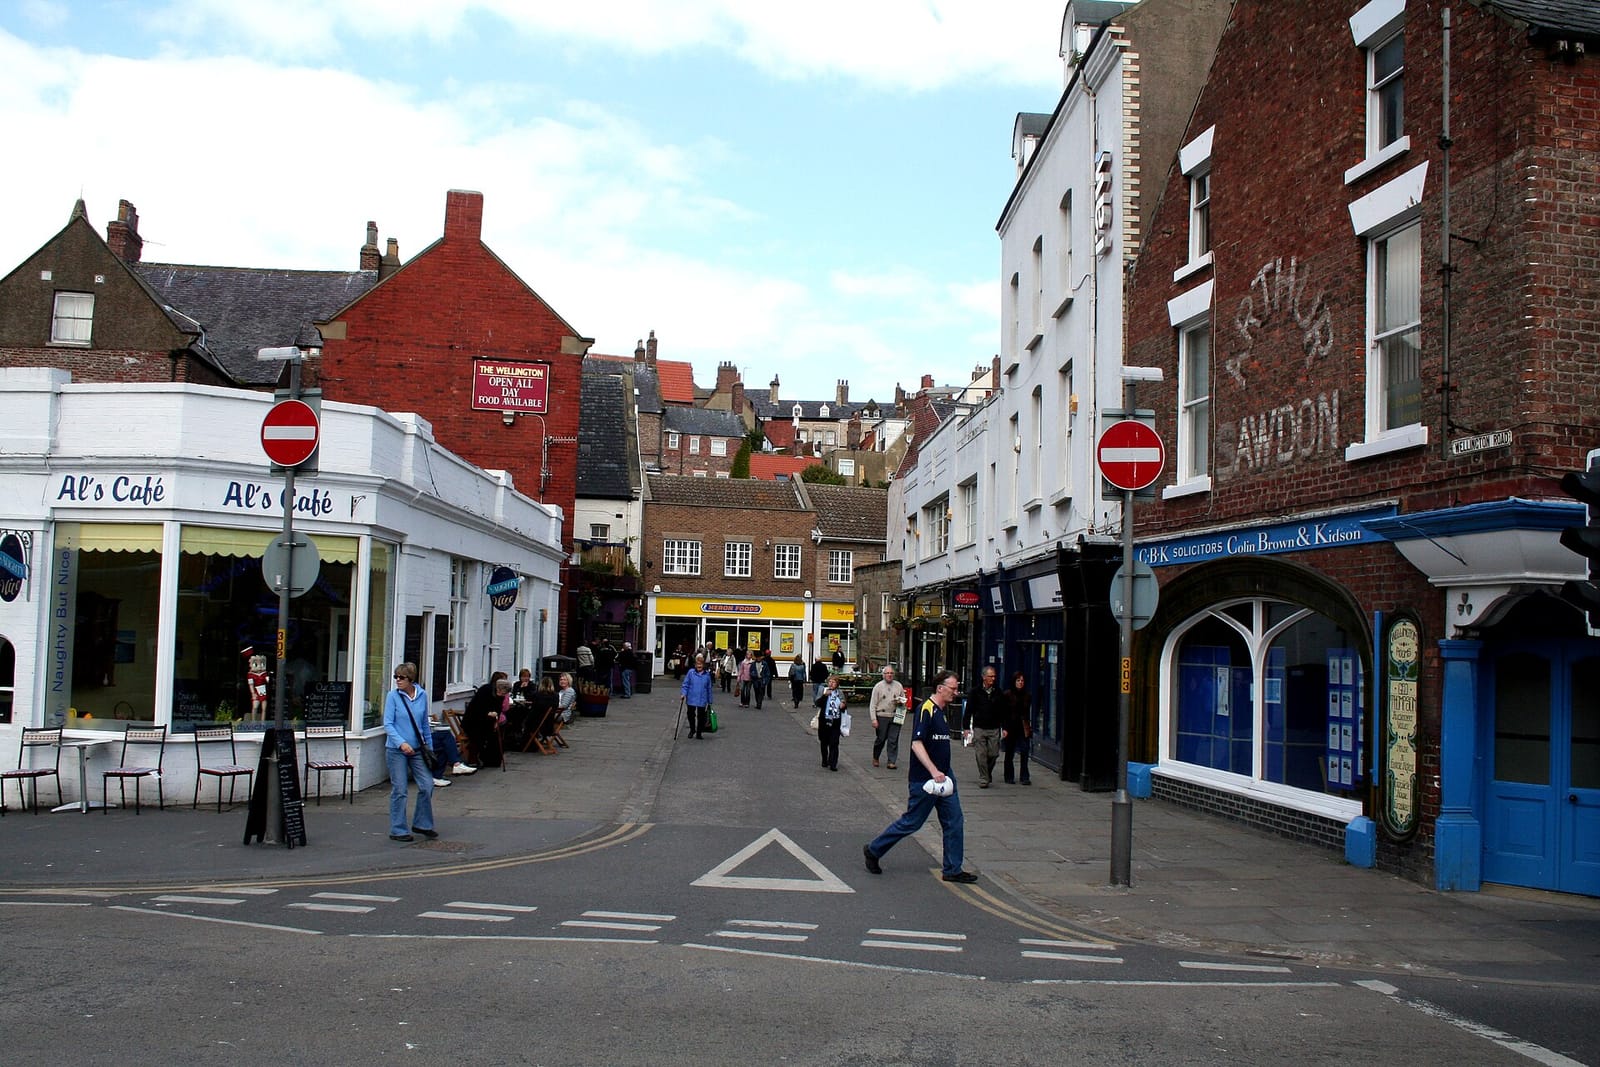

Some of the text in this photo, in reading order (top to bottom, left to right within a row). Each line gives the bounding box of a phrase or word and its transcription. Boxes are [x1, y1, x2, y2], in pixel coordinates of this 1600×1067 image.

[479, 365, 543, 378] THE WELLINGTON
[488, 377, 533, 389] OPEN ALL
[478, 396, 542, 408] FOOD AVAILABLE
[501, 387, 520, 397] DAY
[1454, 432, 1509, 453] WELLINGTON ROAD
[57, 474, 166, 503] Al's Café
[223, 481, 272, 510] Al's
[1172, 541, 1223, 558] SOLICITORS
[1227, 535, 1256, 555] Colin
[1258, 532, 1295, 551] Brown
[1297, 526, 1311, 548] &
[1314, 522, 1362, 545] Kidson
[56, 591, 68, 618] But
[52, 624, 69, 692] Naughty
